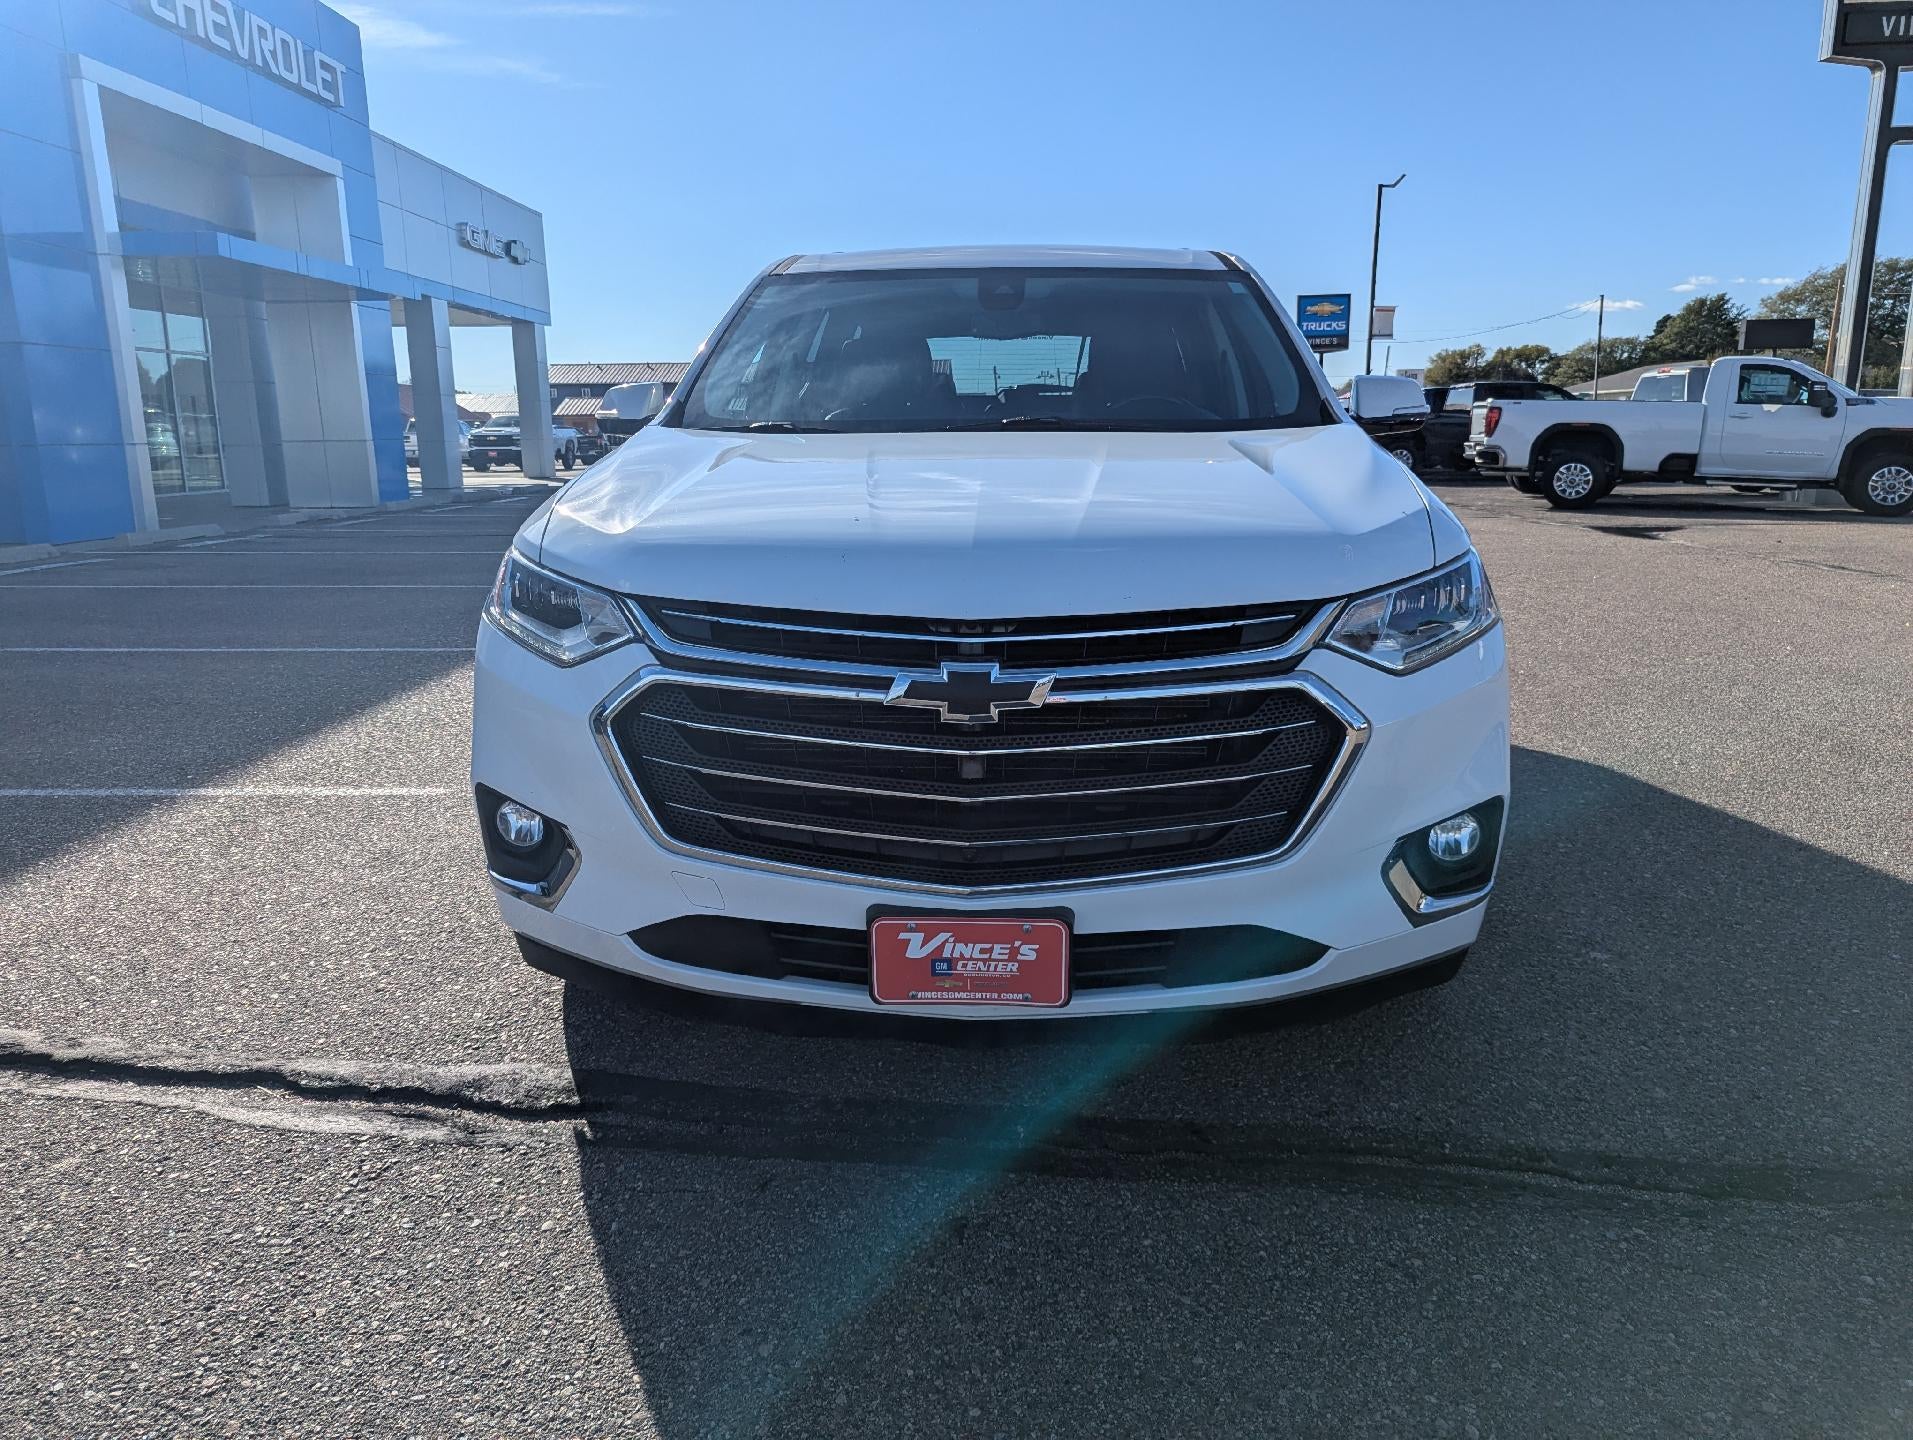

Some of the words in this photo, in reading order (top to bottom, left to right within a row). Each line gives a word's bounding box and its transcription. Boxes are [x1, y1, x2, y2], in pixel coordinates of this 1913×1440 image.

[1302, 321, 1346, 331] TRUCKS
[935, 962, 948, 970] GM
[956, 960, 1019, 972] CENTER
